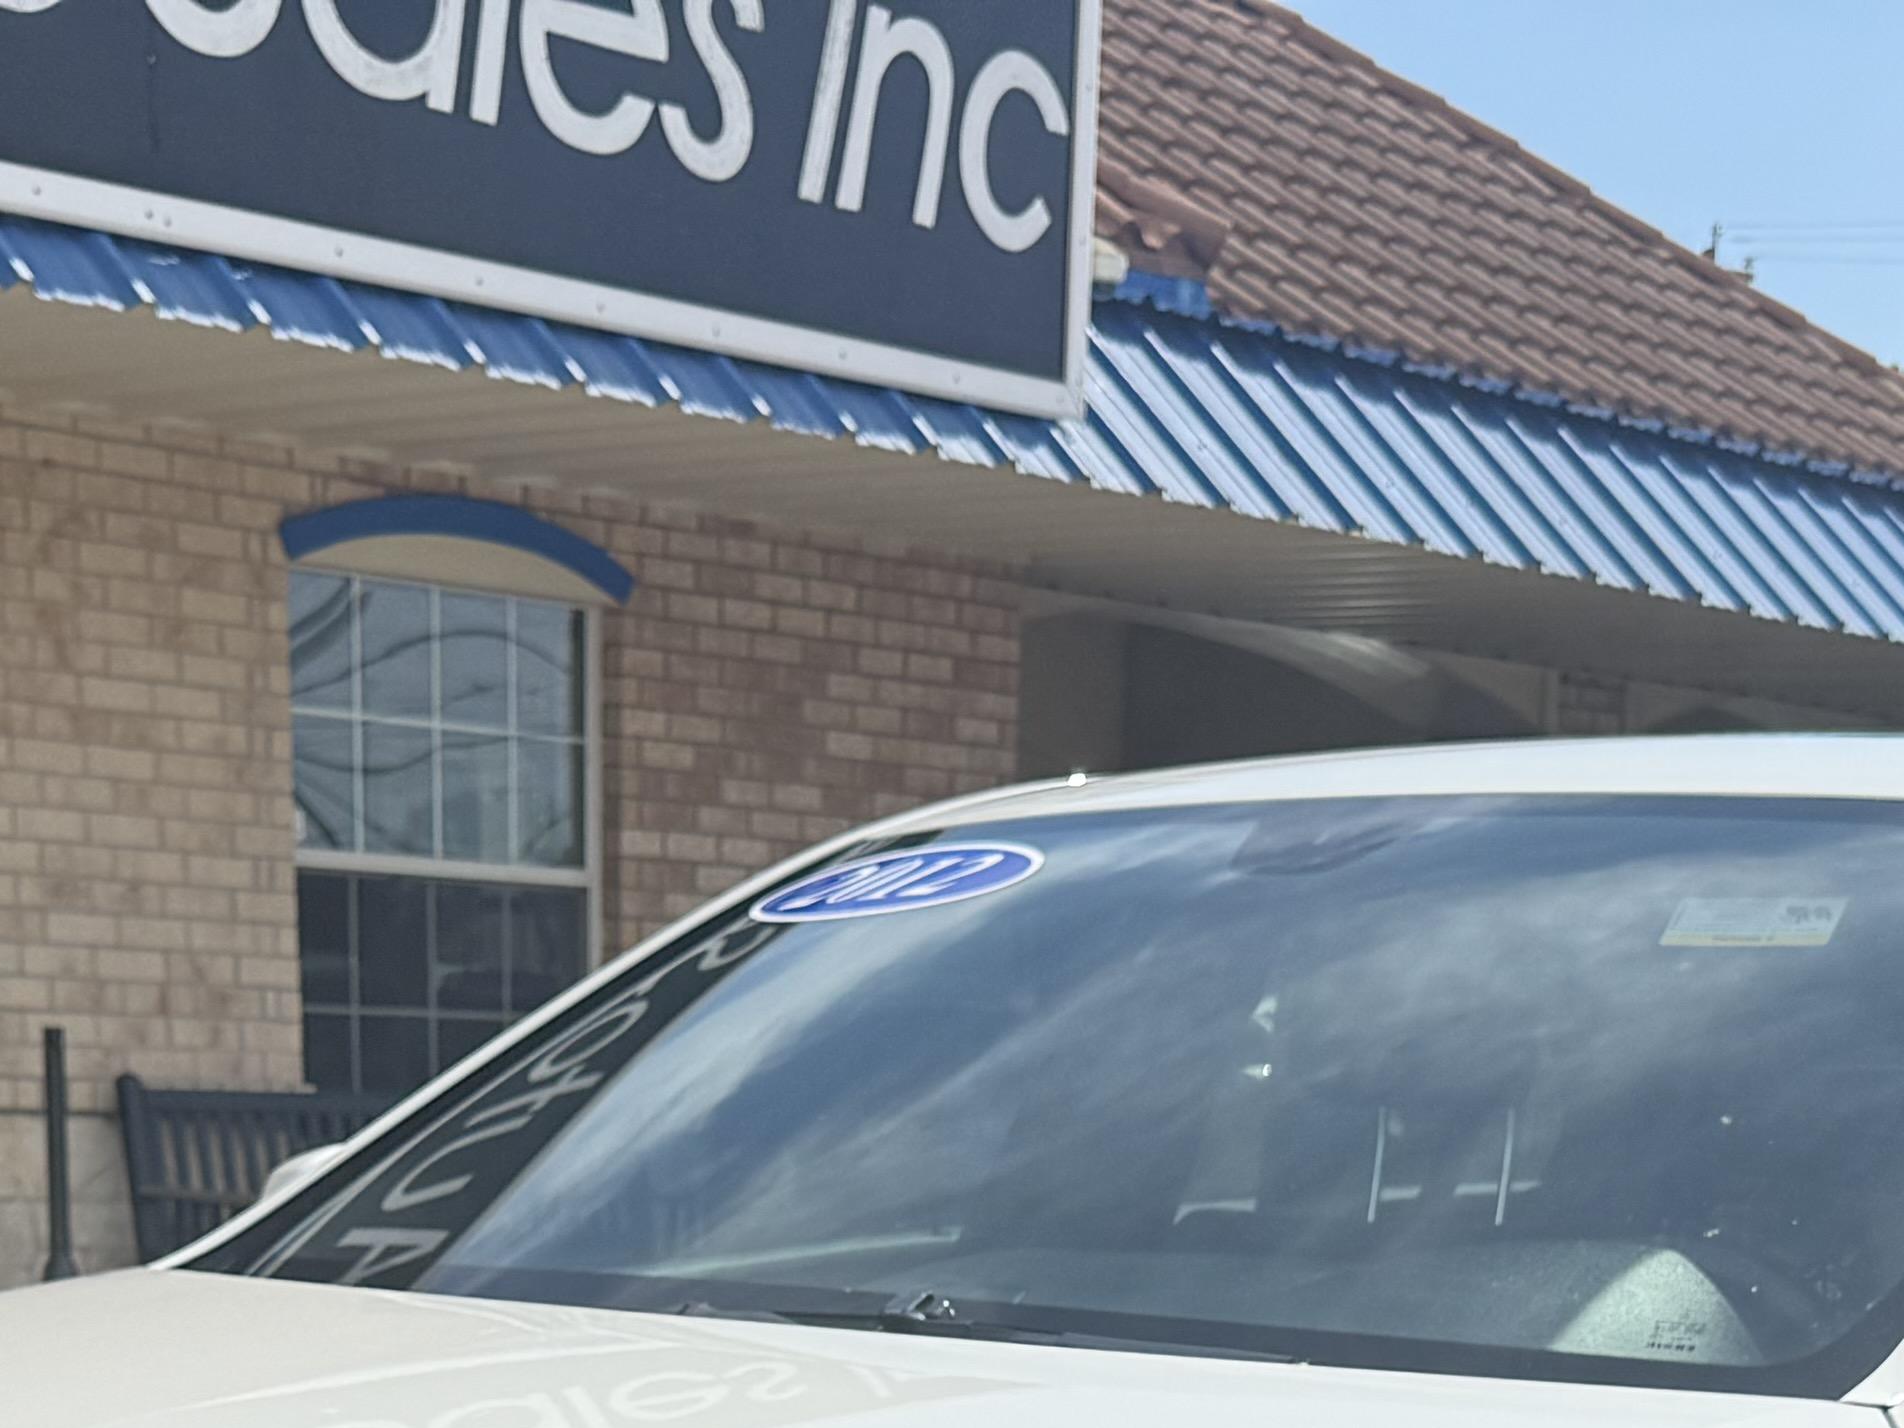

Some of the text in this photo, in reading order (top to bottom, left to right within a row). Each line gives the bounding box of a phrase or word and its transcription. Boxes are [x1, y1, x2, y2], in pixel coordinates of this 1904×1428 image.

[142, 0, 1069, 253] aes Inc
[778, 851, 1005, 912] 2012
